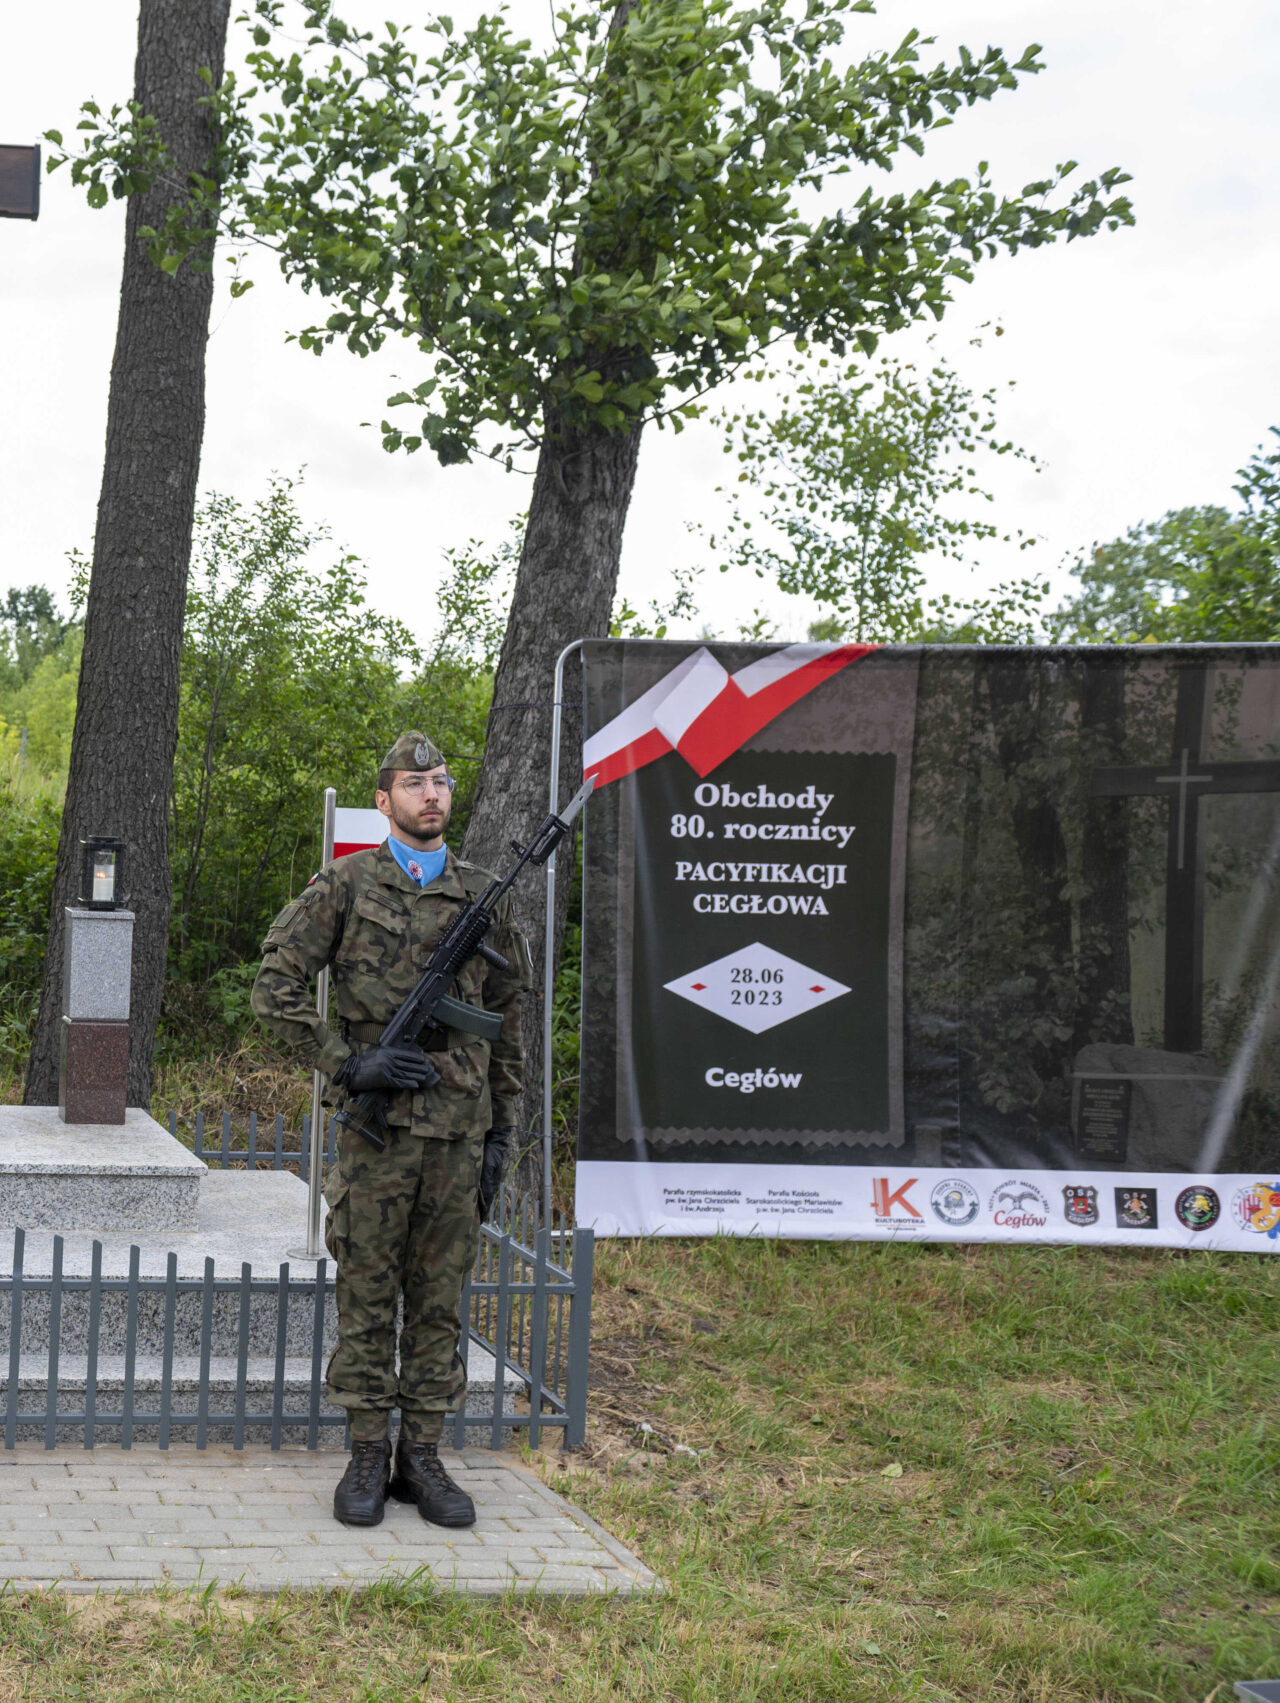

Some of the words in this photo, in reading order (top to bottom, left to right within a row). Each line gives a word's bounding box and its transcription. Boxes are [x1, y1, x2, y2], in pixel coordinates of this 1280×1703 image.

[694, 783, 835, 816] Obchody
[670, 814, 715, 838] 80.
[723, 817, 856, 849] rocznicy
[675, 861, 847, 889] PACYFIKACJI
[693, 893, 830, 915] CEGŁOWA
[730, 967, 784, 984] 28.06
[731, 989, 783, 1006] 2023
[704, 1067, 803, 1093] Cegłów
[993, 1210, 1047, 1229] Cegłów
